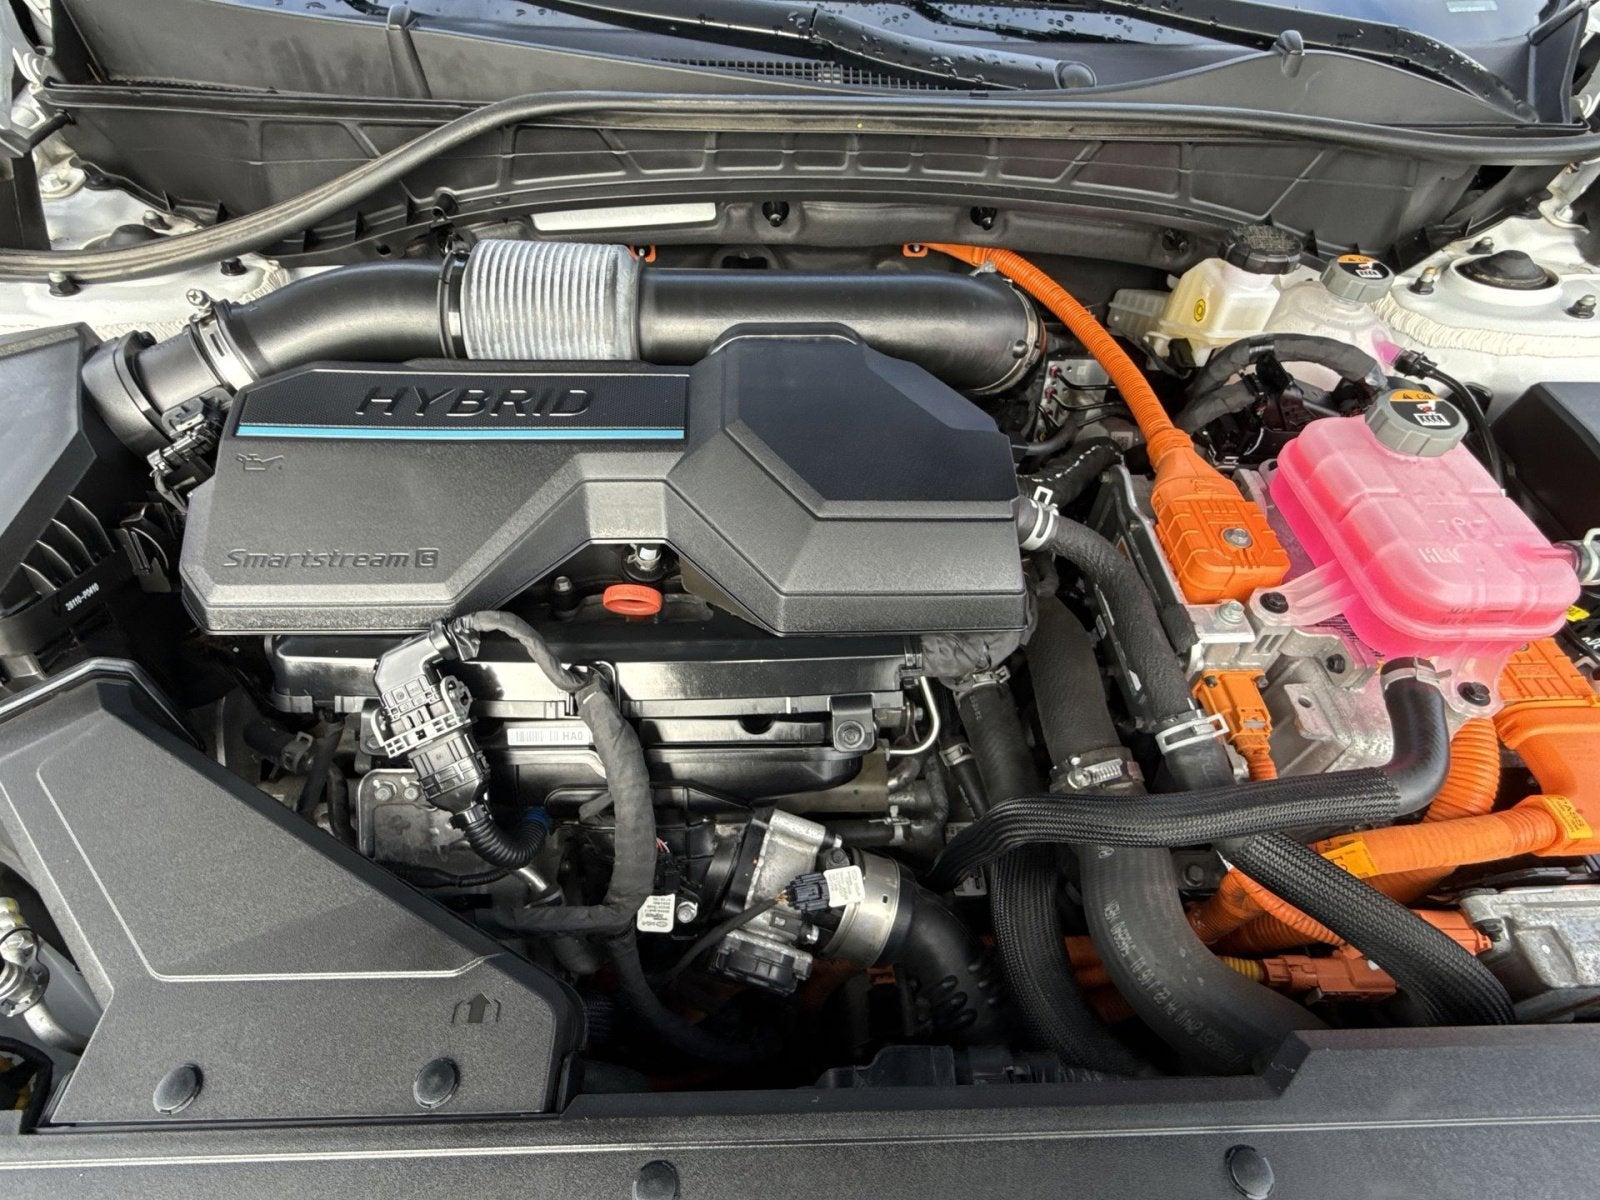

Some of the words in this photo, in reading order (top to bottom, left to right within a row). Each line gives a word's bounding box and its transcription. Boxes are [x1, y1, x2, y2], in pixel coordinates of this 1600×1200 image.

[355, 387, 593, 417] HYBRID
[223, 548, 410, 568] Smartstream
[416, 549, 437, 568] G
